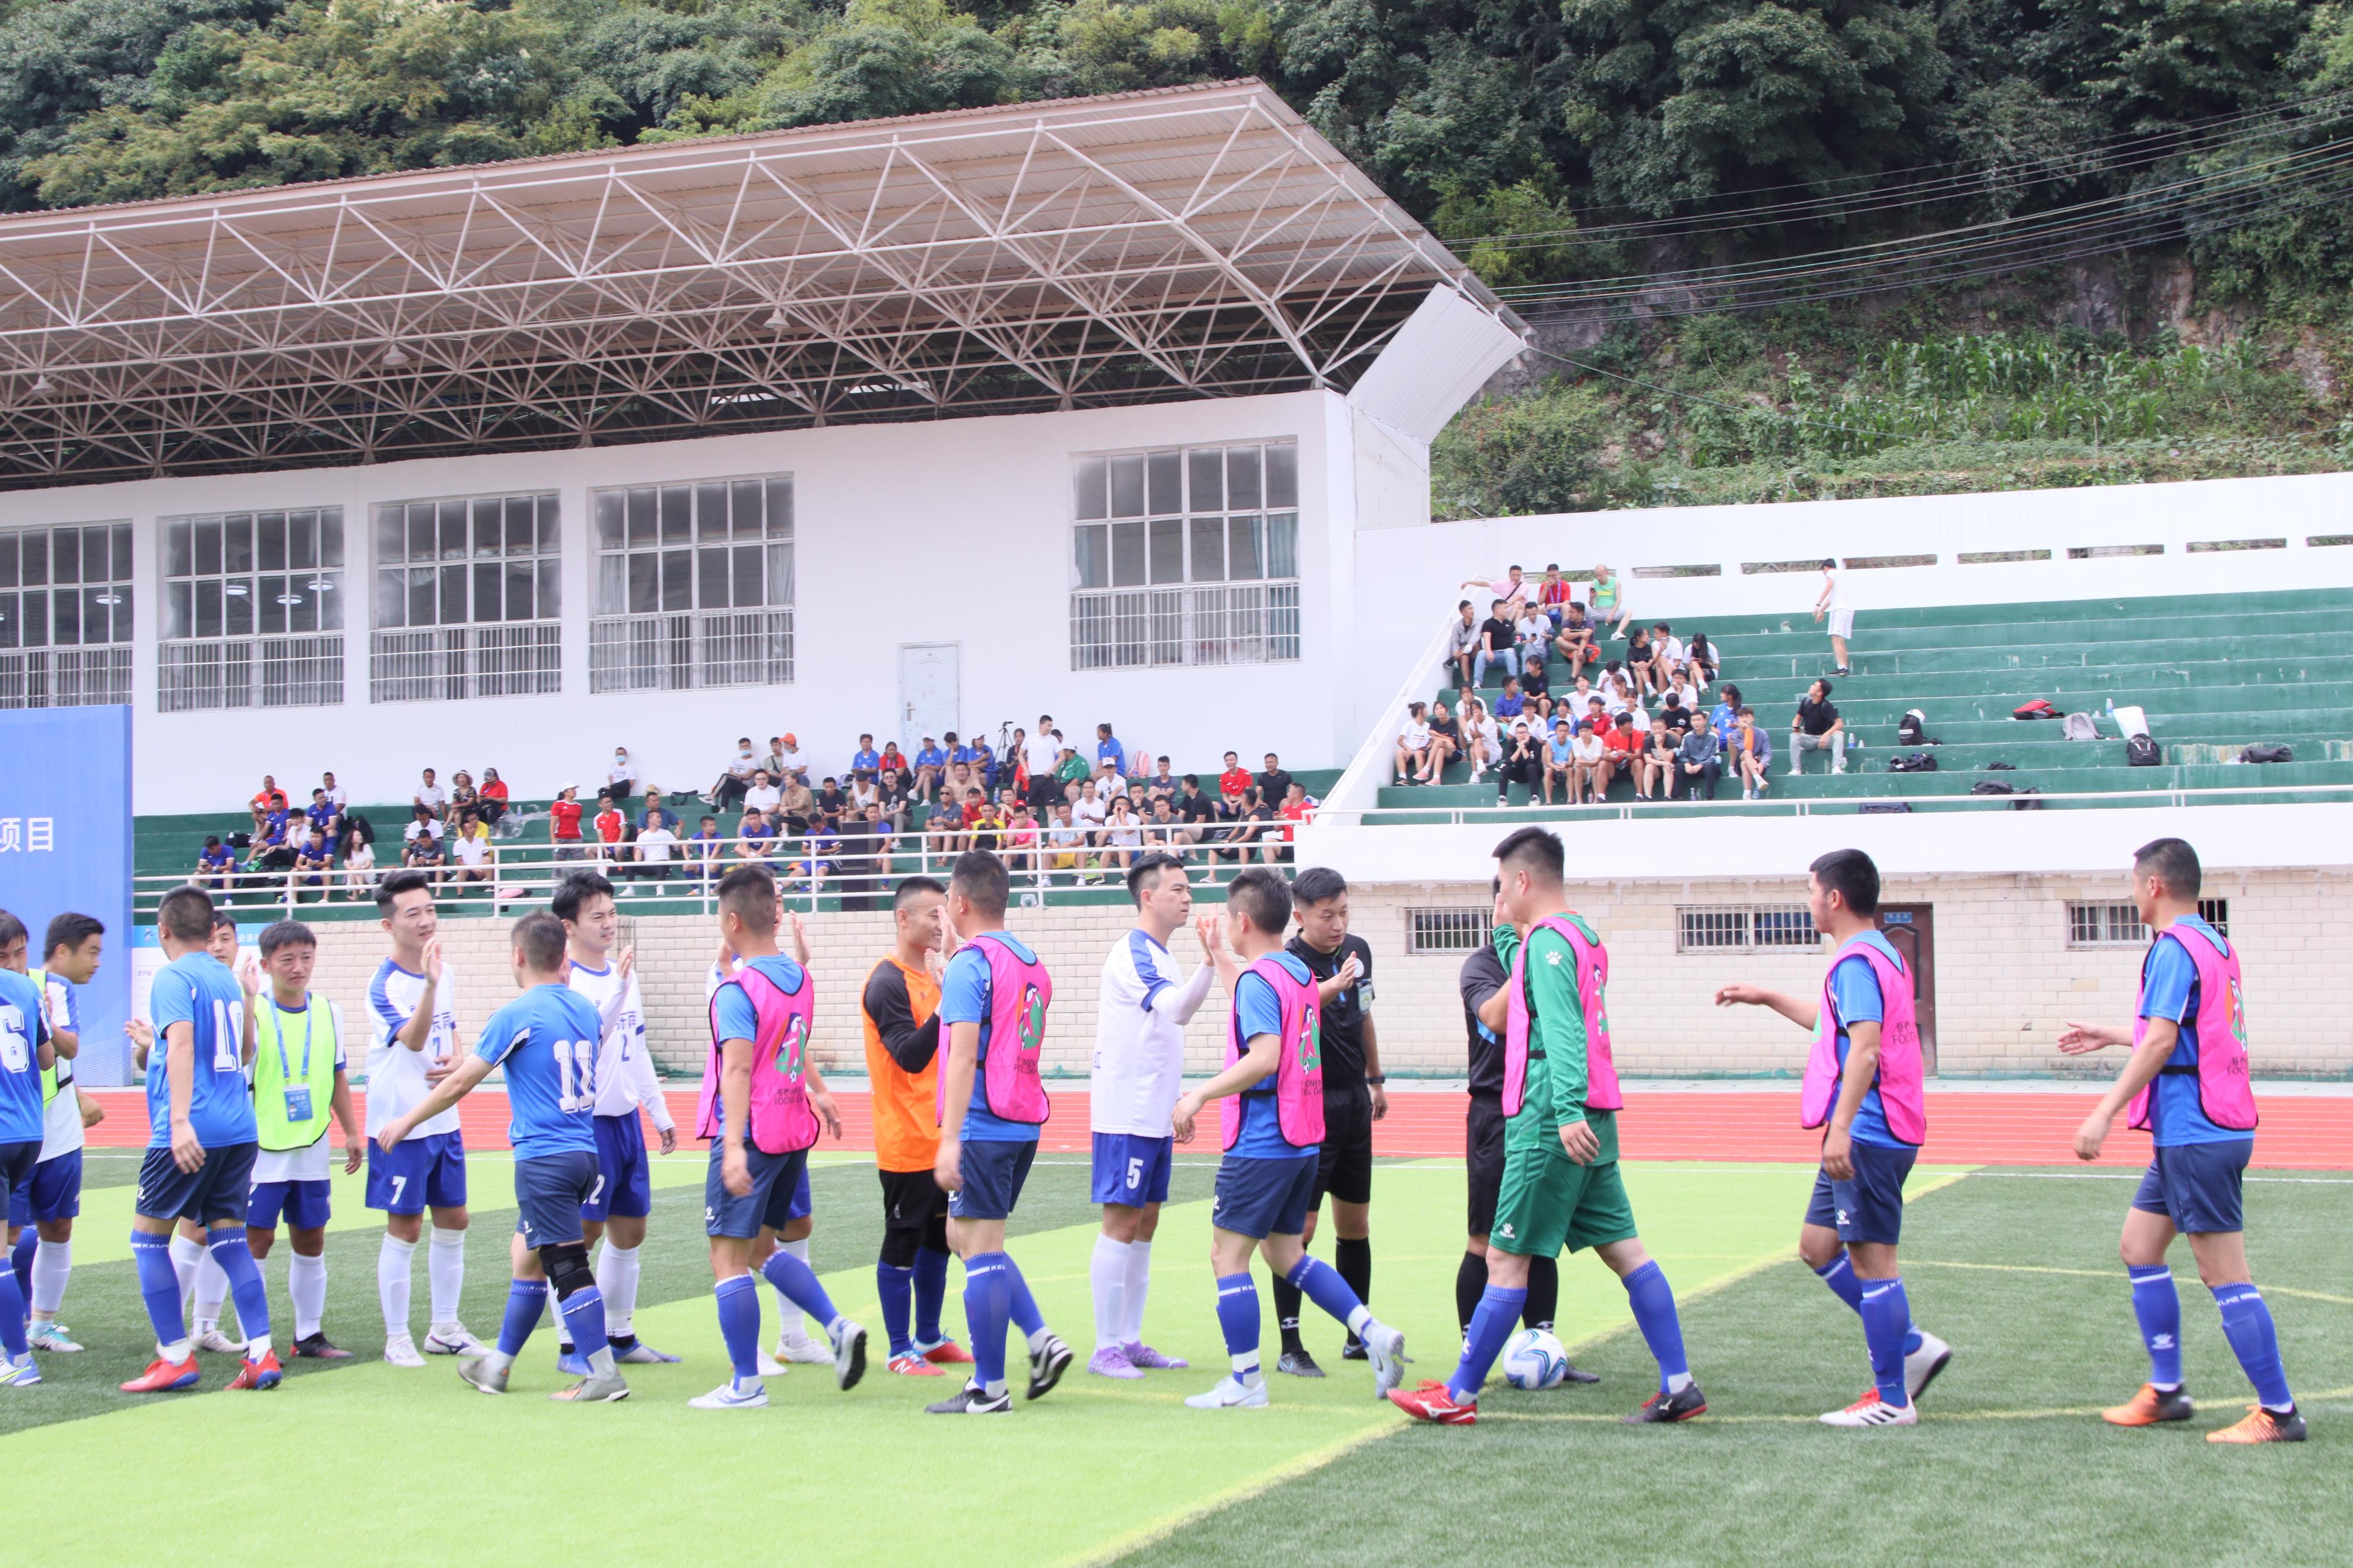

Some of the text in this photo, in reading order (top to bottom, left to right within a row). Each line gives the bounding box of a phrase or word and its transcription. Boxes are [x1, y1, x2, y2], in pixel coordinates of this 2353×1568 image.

[553, 1039, 596, 1114] 11
[1126, 1157, 1144, 1189] 5
[390, 1175, 408, 1205] 7
